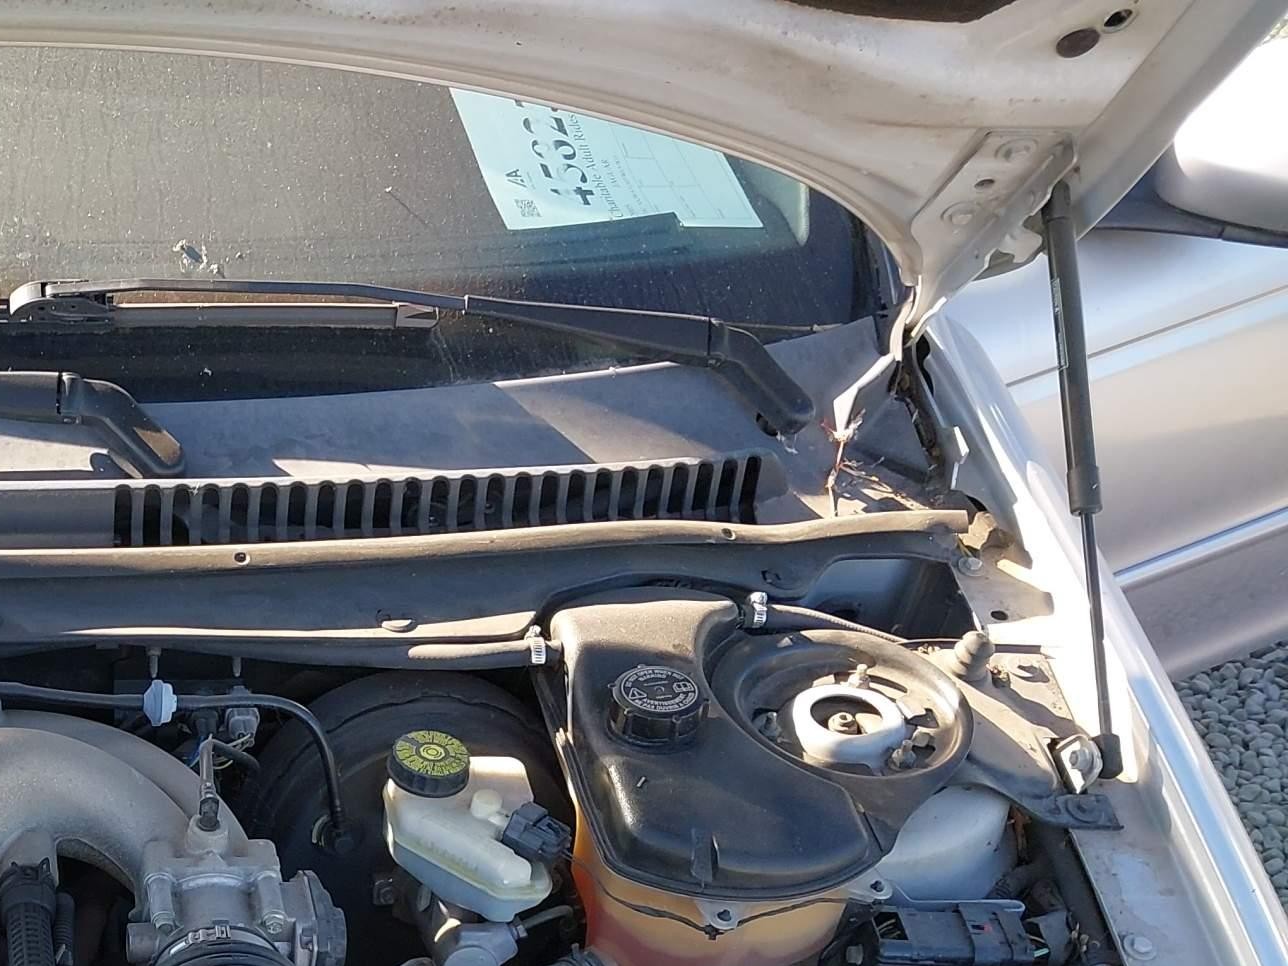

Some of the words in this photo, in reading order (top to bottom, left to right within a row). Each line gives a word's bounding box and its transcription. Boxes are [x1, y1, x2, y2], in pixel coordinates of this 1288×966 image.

[568, 113, 586, 141] Rides
[579, 144, 596, 169] Adult
[594, 173, 623, 218] Charitable
